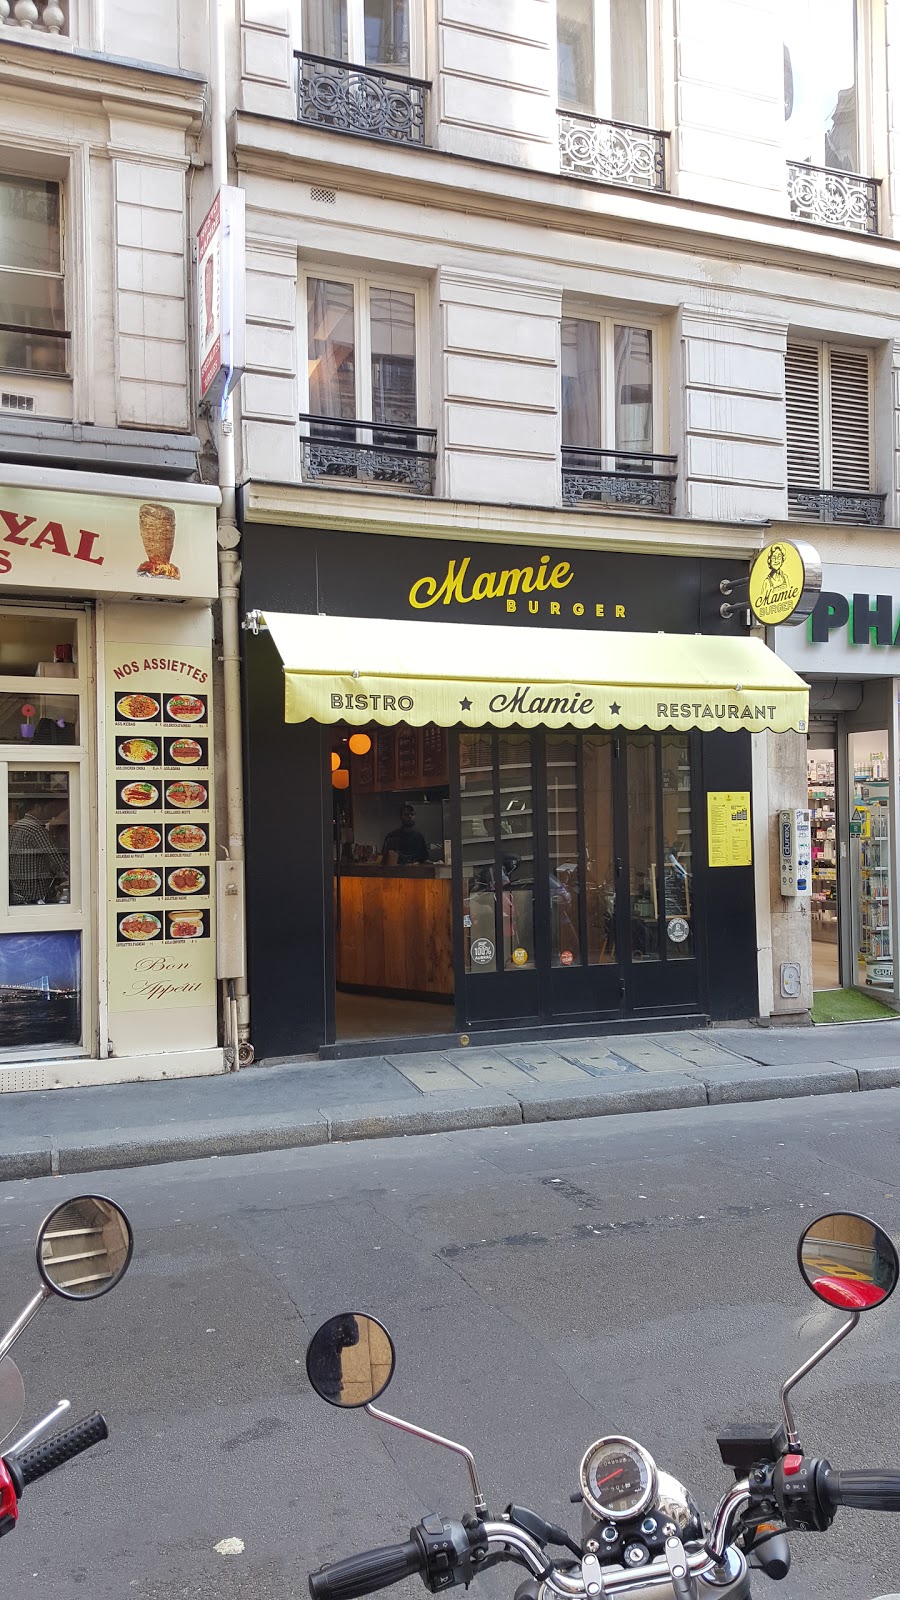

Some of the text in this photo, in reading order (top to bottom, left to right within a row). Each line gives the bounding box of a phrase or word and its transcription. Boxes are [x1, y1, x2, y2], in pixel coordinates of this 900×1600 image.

[0, 510, 105, 566] YAL
[409, 555, 574, 609] Mamie
[754, 585, 799, 608] Mamie
[506, 600, 626, 618] BURGER
[759, 600, 794, 618] BURGER
[811, 591, 900, 646] PH
[113, 658, 208, 684] NOS ASSIETTES
[330, 686, 777, 720] BISTRO Mamie RESTAURANT
[474, 946, 492, 956] 100%
[134, 955, 192, 973] Bon
